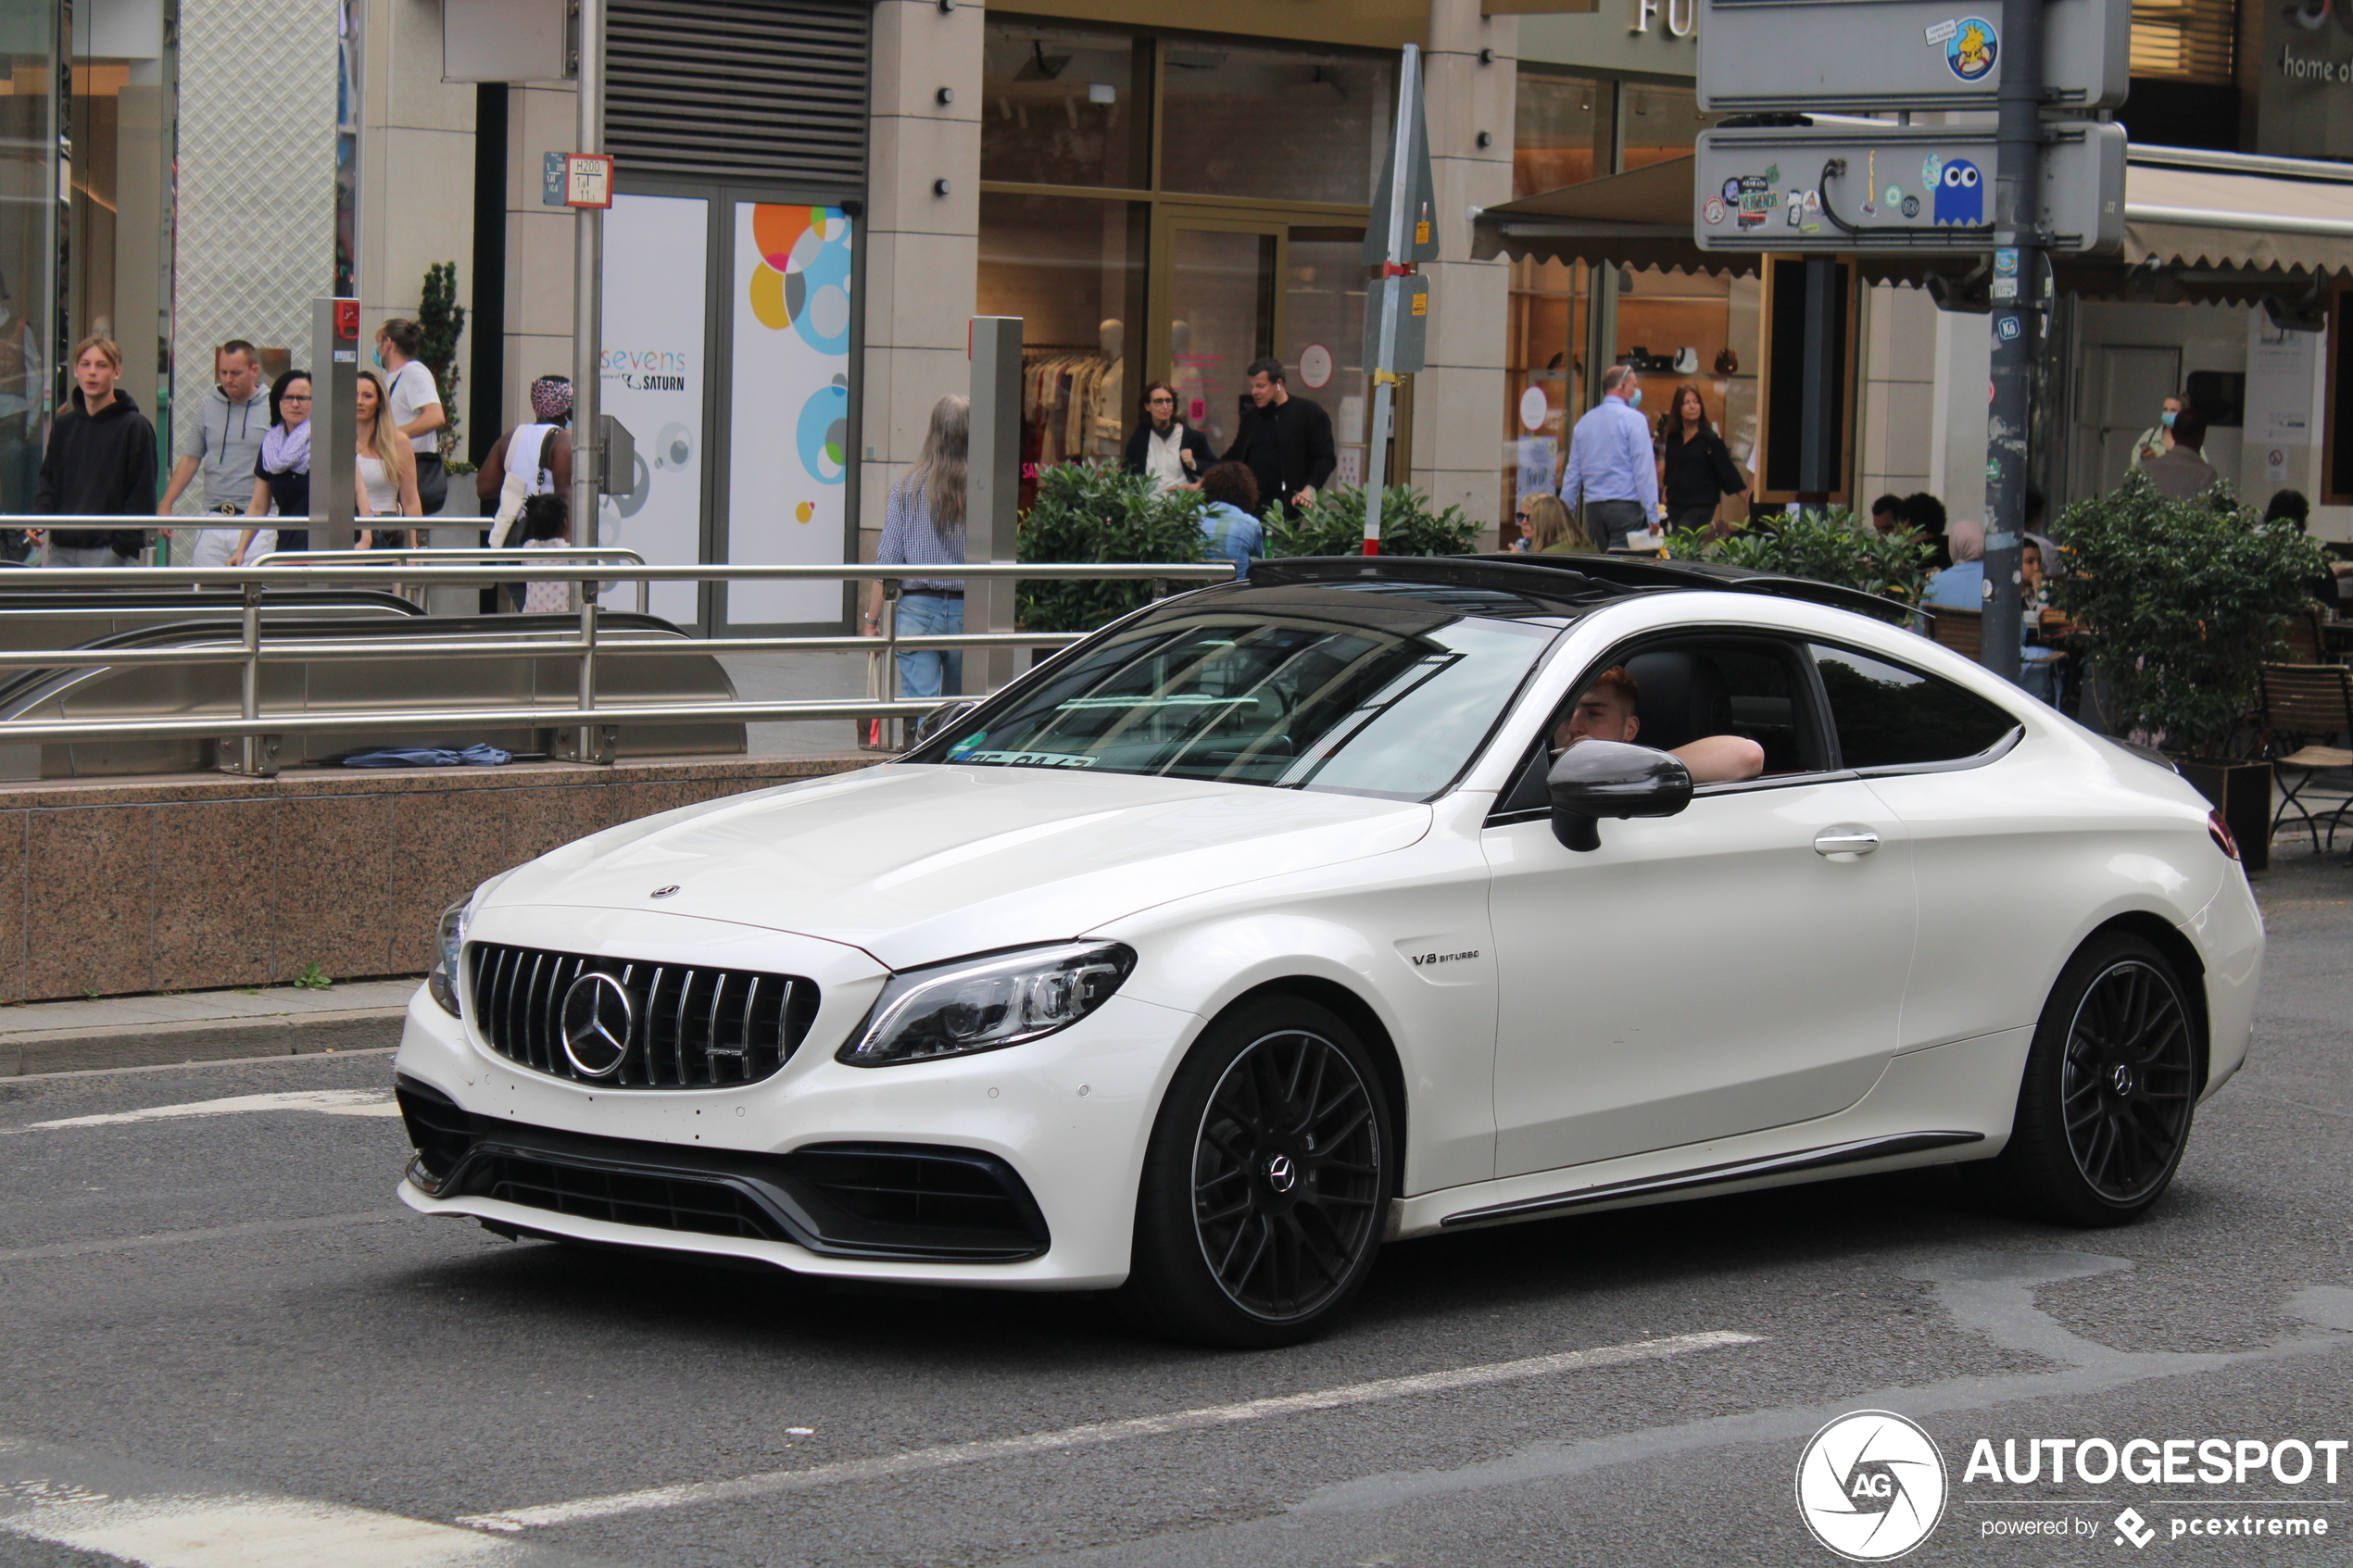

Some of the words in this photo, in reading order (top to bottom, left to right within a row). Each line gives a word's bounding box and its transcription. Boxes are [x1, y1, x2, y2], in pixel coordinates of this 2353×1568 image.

[1638, 0, 1693, 36] FU
[2284, 43, 2334, 82] home
[576, 160, 600, 172] H200
[2002, 320, 2017, 336] Kö
[600, 349, 686, 371] sevens
[643, 375, 685, 391] SATURN
[1412, 953, 1437, 966] V8
[1439, 949, 1480, 963] BITURBO
